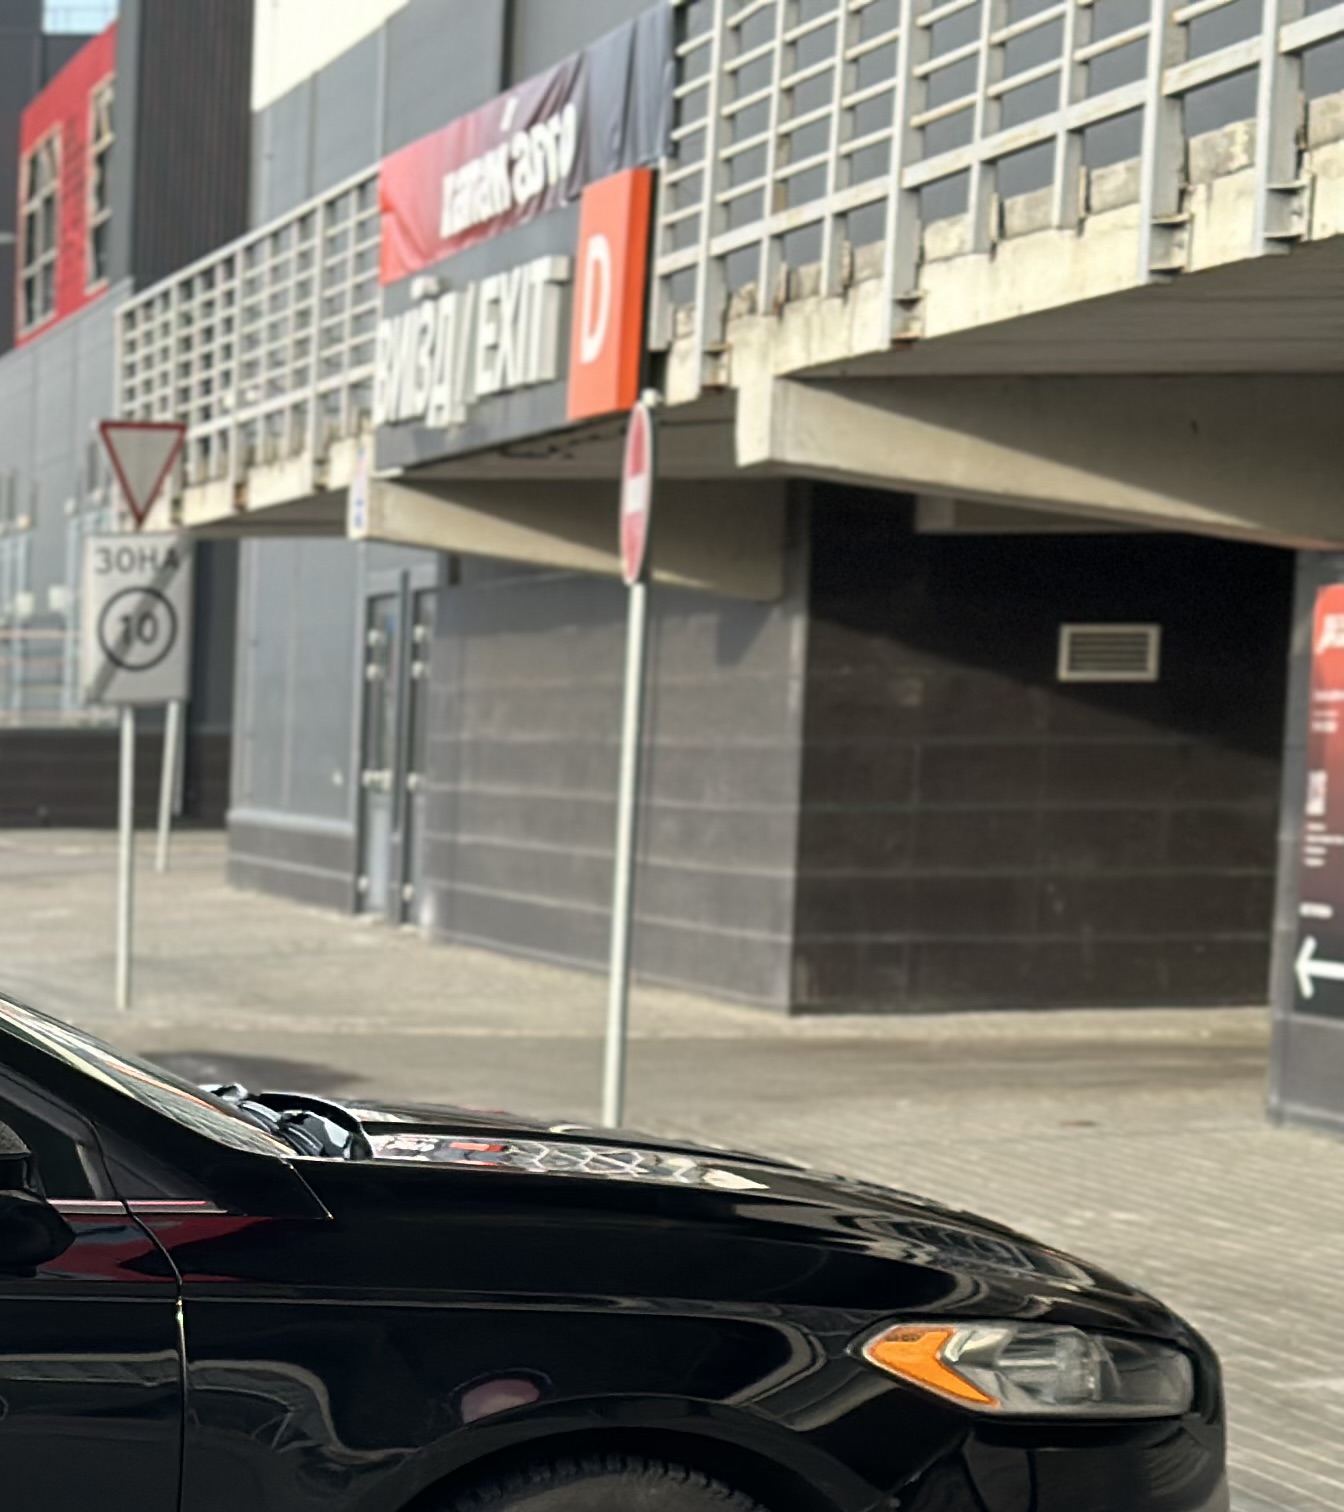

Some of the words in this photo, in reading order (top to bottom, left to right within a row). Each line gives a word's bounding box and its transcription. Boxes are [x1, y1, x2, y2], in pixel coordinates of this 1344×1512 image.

[475, 255, 570, 396] EXIT
[579, 234, 611, 364] D
[95, 546, 181, 575] ЗОНА
